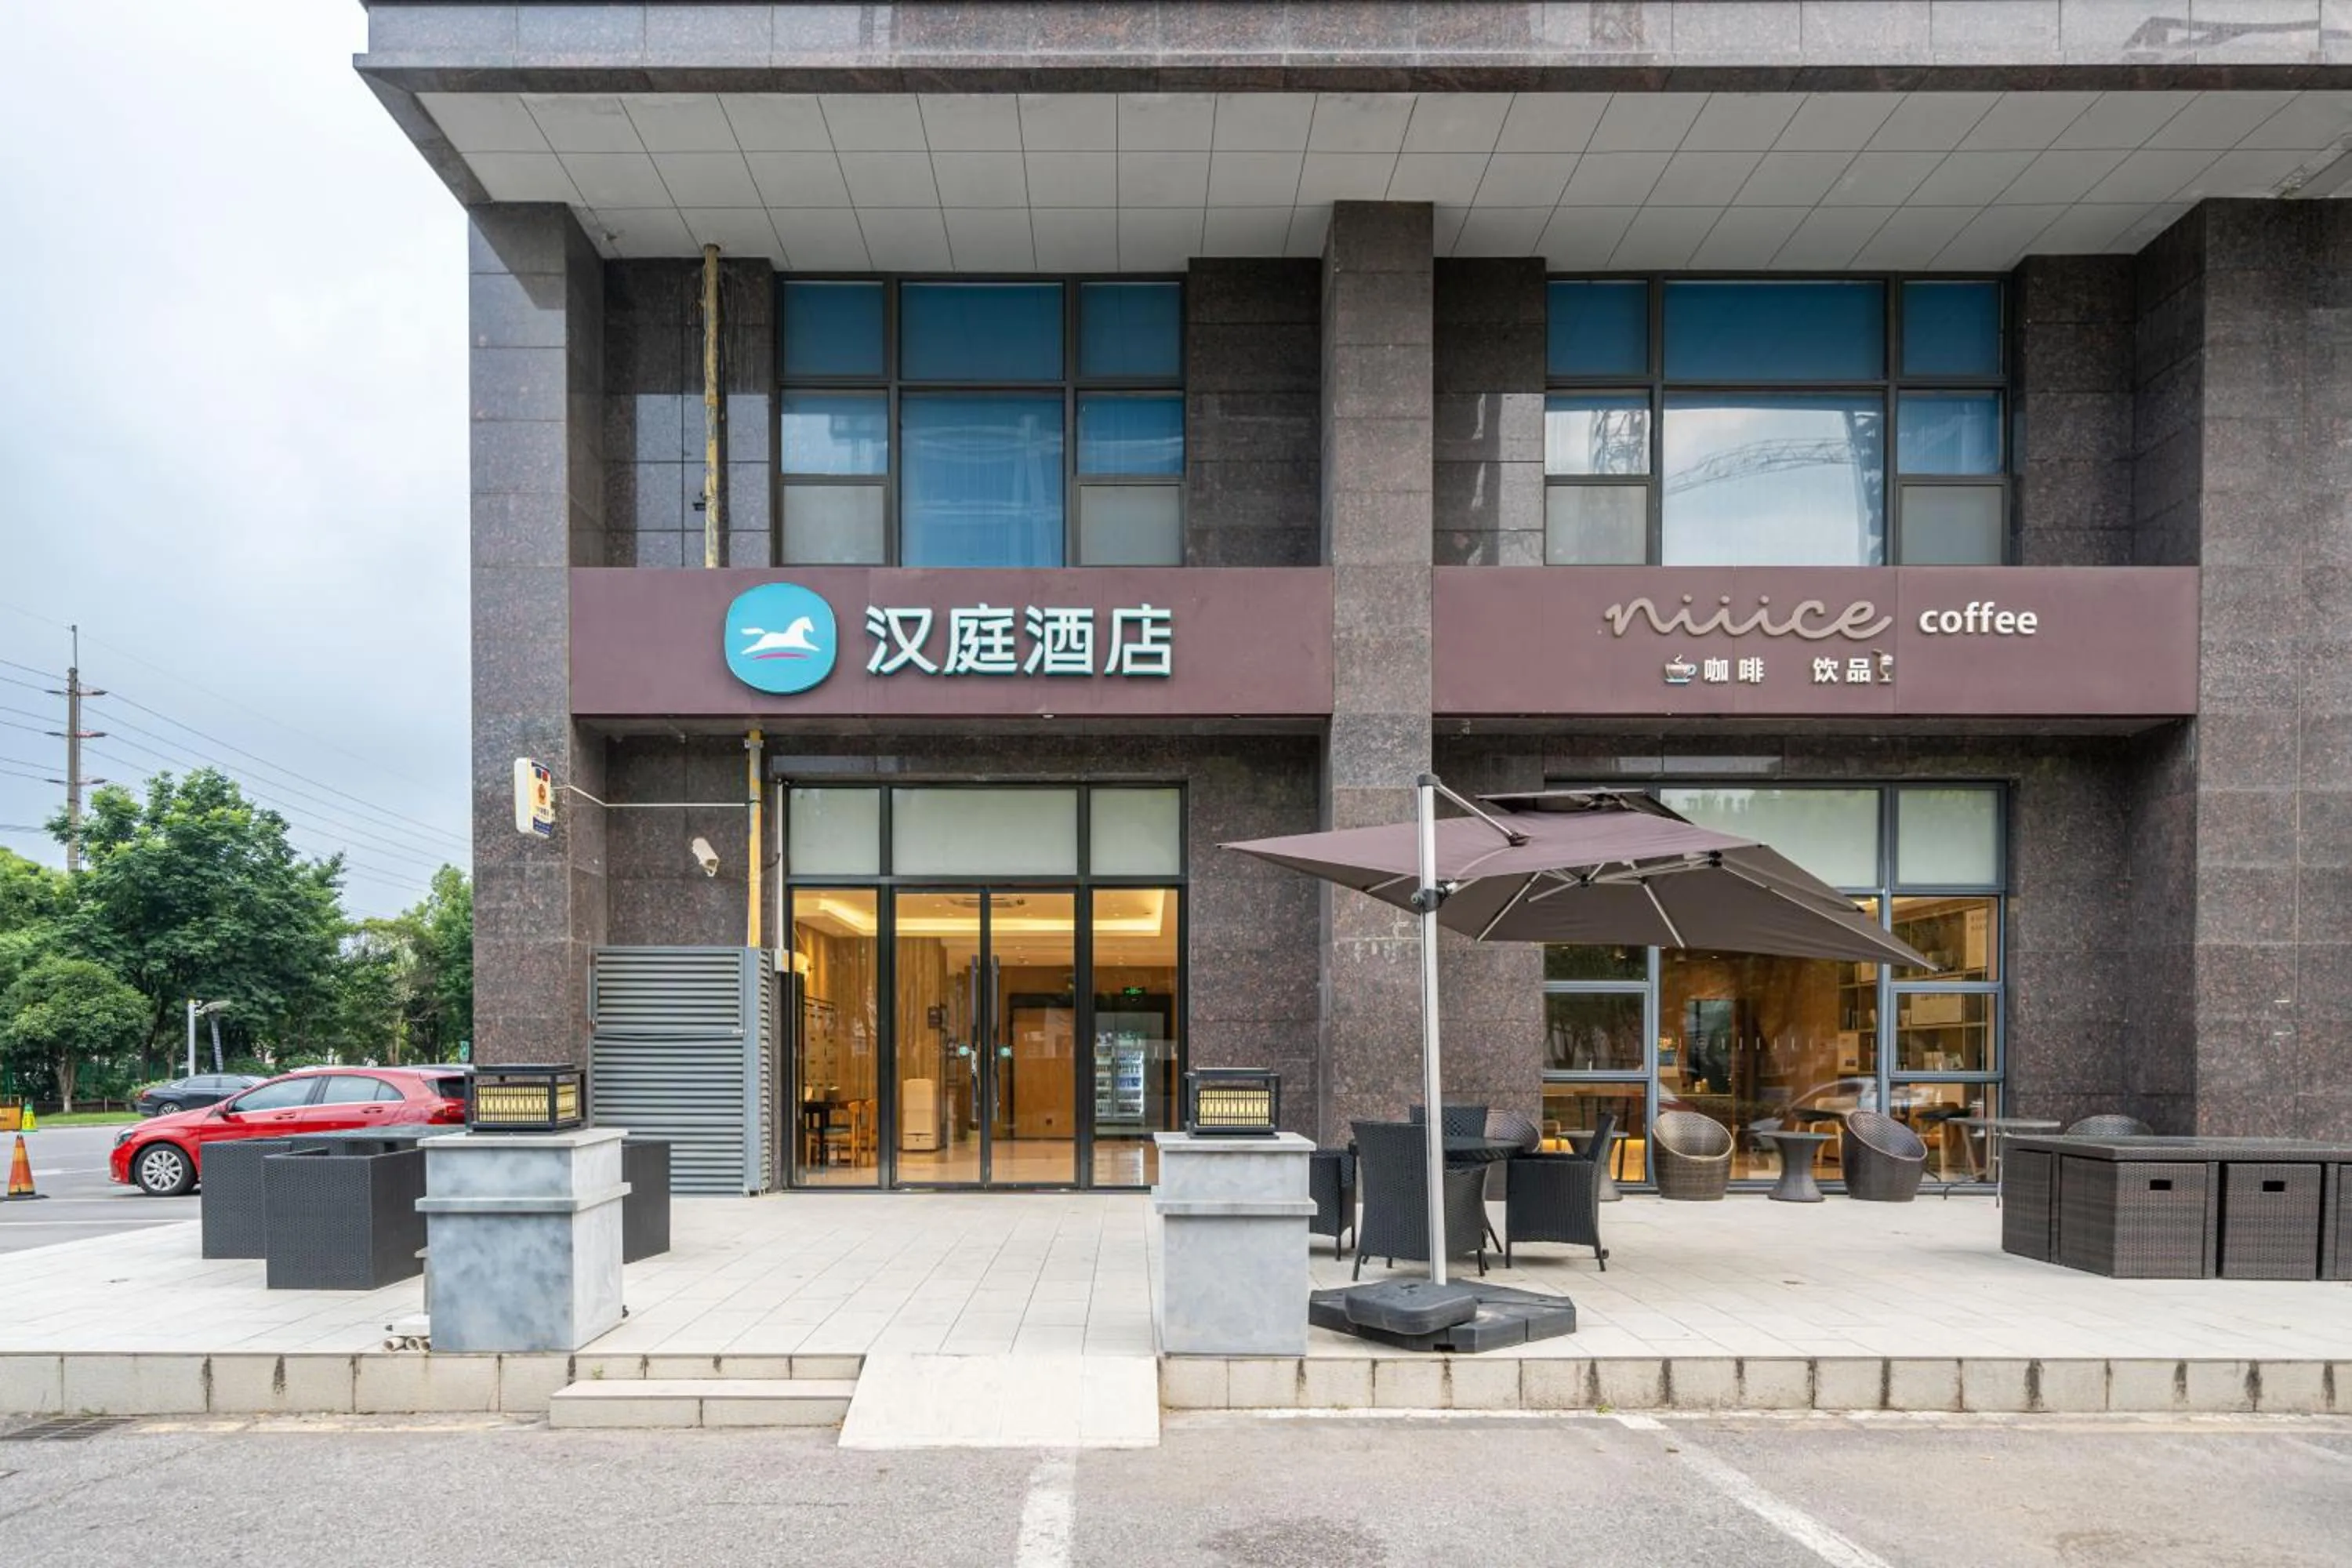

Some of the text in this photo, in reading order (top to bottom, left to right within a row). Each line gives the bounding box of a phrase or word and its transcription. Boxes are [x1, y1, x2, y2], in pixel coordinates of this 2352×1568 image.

[1919, 601, 2038, 635] coffee
[865, 603, 1173, 676] 汉庭酒店
[1704, 657, 1871, 684] 咖啡 饮品
